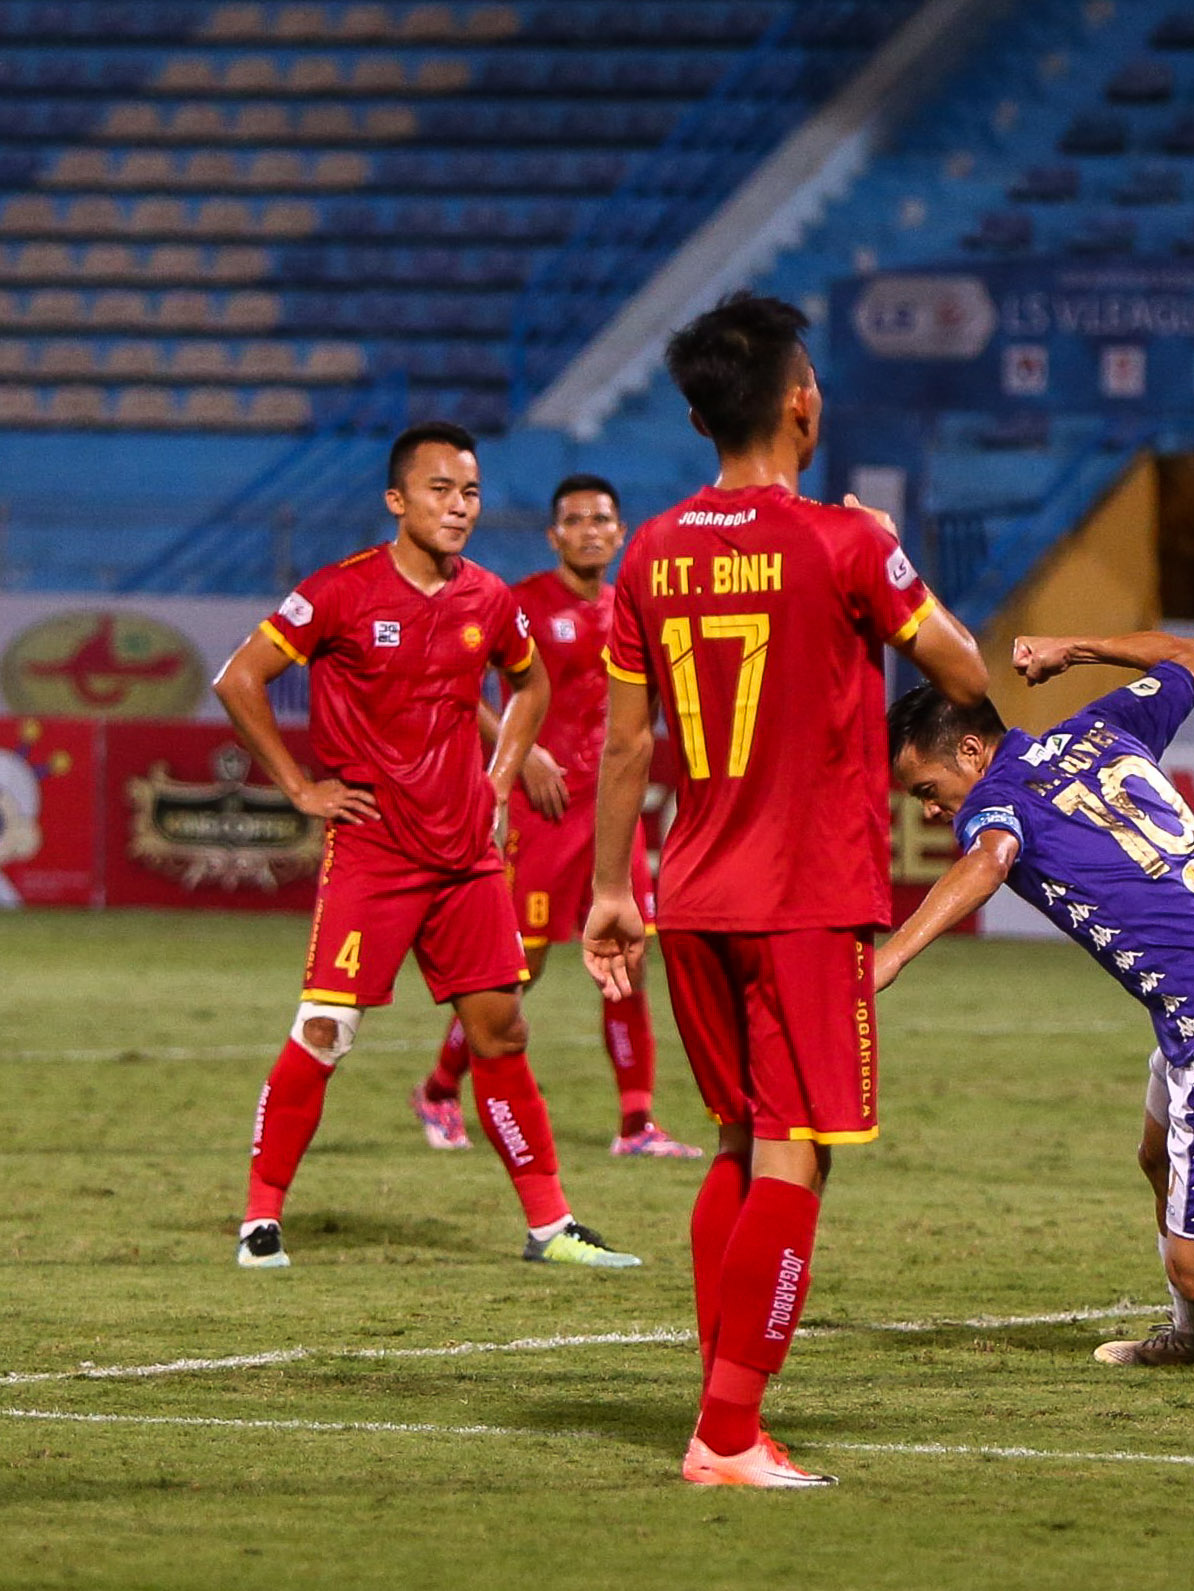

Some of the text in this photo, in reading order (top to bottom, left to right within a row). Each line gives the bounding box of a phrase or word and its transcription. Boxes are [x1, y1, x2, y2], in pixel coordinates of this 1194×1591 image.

[679, 508, 757, 527] JOGARBOLA
[652, 550, 783, 597] H.T. BÌNH
[661, 613, 771, 780] 17
[334, 930, 362, 978] 4
[764, 1247, 805, 1341] JOGARBOLA
